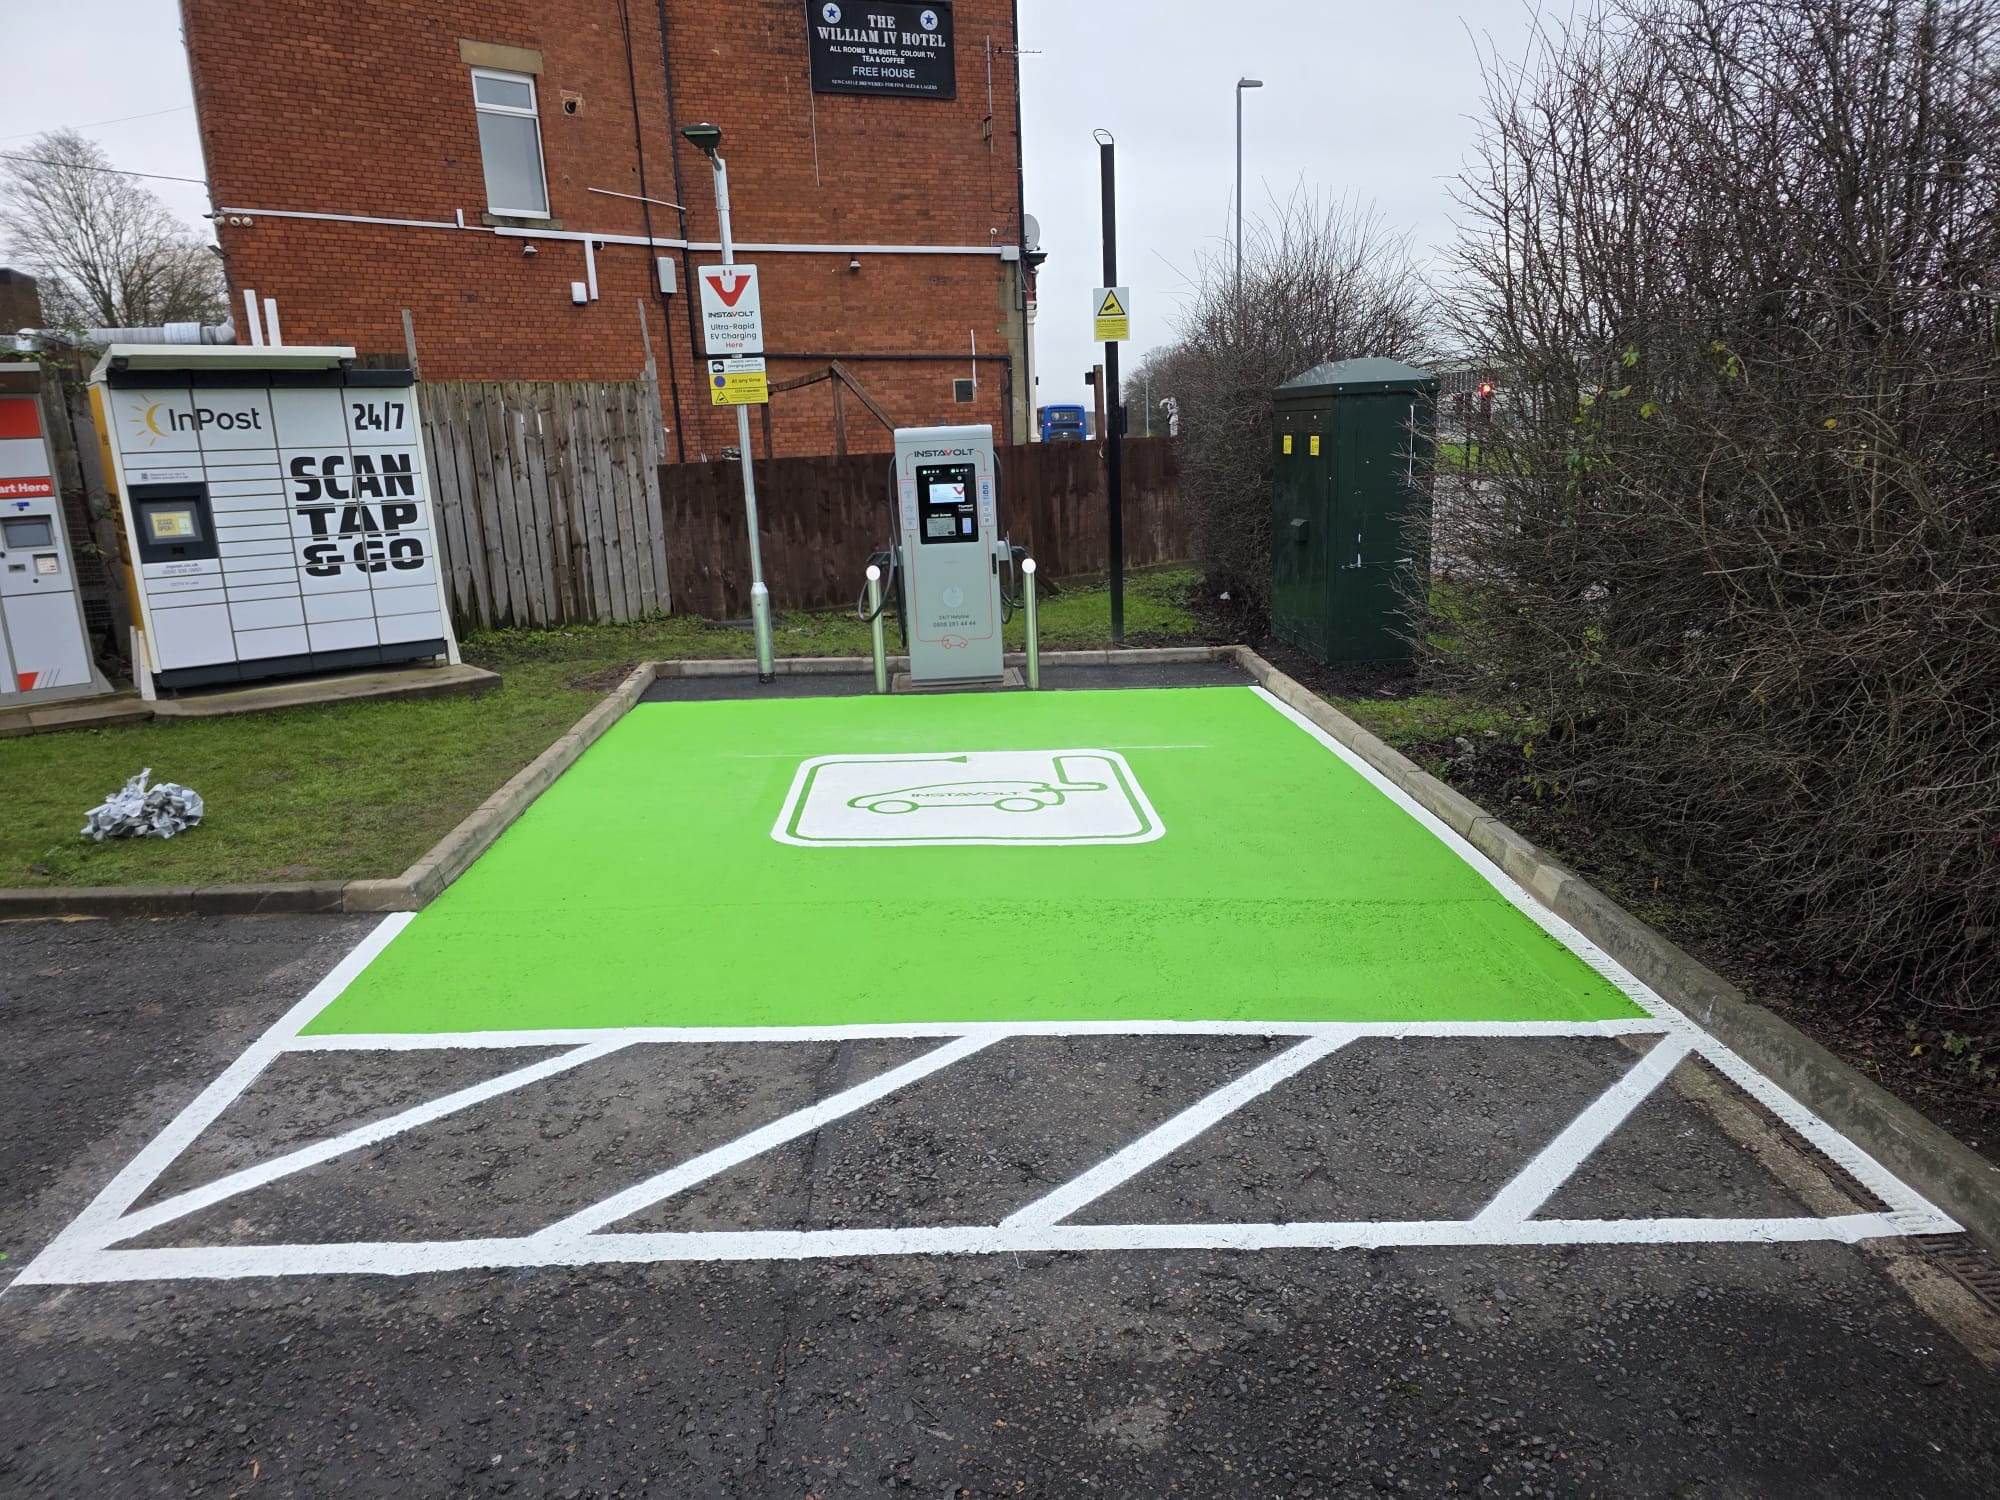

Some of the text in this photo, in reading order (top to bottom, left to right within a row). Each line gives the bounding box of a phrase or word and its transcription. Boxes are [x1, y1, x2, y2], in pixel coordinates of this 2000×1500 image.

[867, 14, 896, 29] THE
[817, 26, 946, 48] WILLIAM IV HOTEL
[830, 45, 936, 60] ALL ROOMS EN-SUITE, COLOUR TV,
[881, 56, 905, 64] COFFEE
[852, 66, 916, 78] FREE HOUSE
[710, 322, 754, 331] Ultra-Rapid
[722, 332, 756, 340] Charging
[168, 408, 262, 430] InPost
[352, 402, 404, 432] 24/7
[914, 448, 974, 458] INSTAVOLT
[290, 454, 414, 501] SCAN
[18, 483, 49, 492] Here
[296, 499, 418, 541] TAP
[303, 538, 424, 576] & GO
